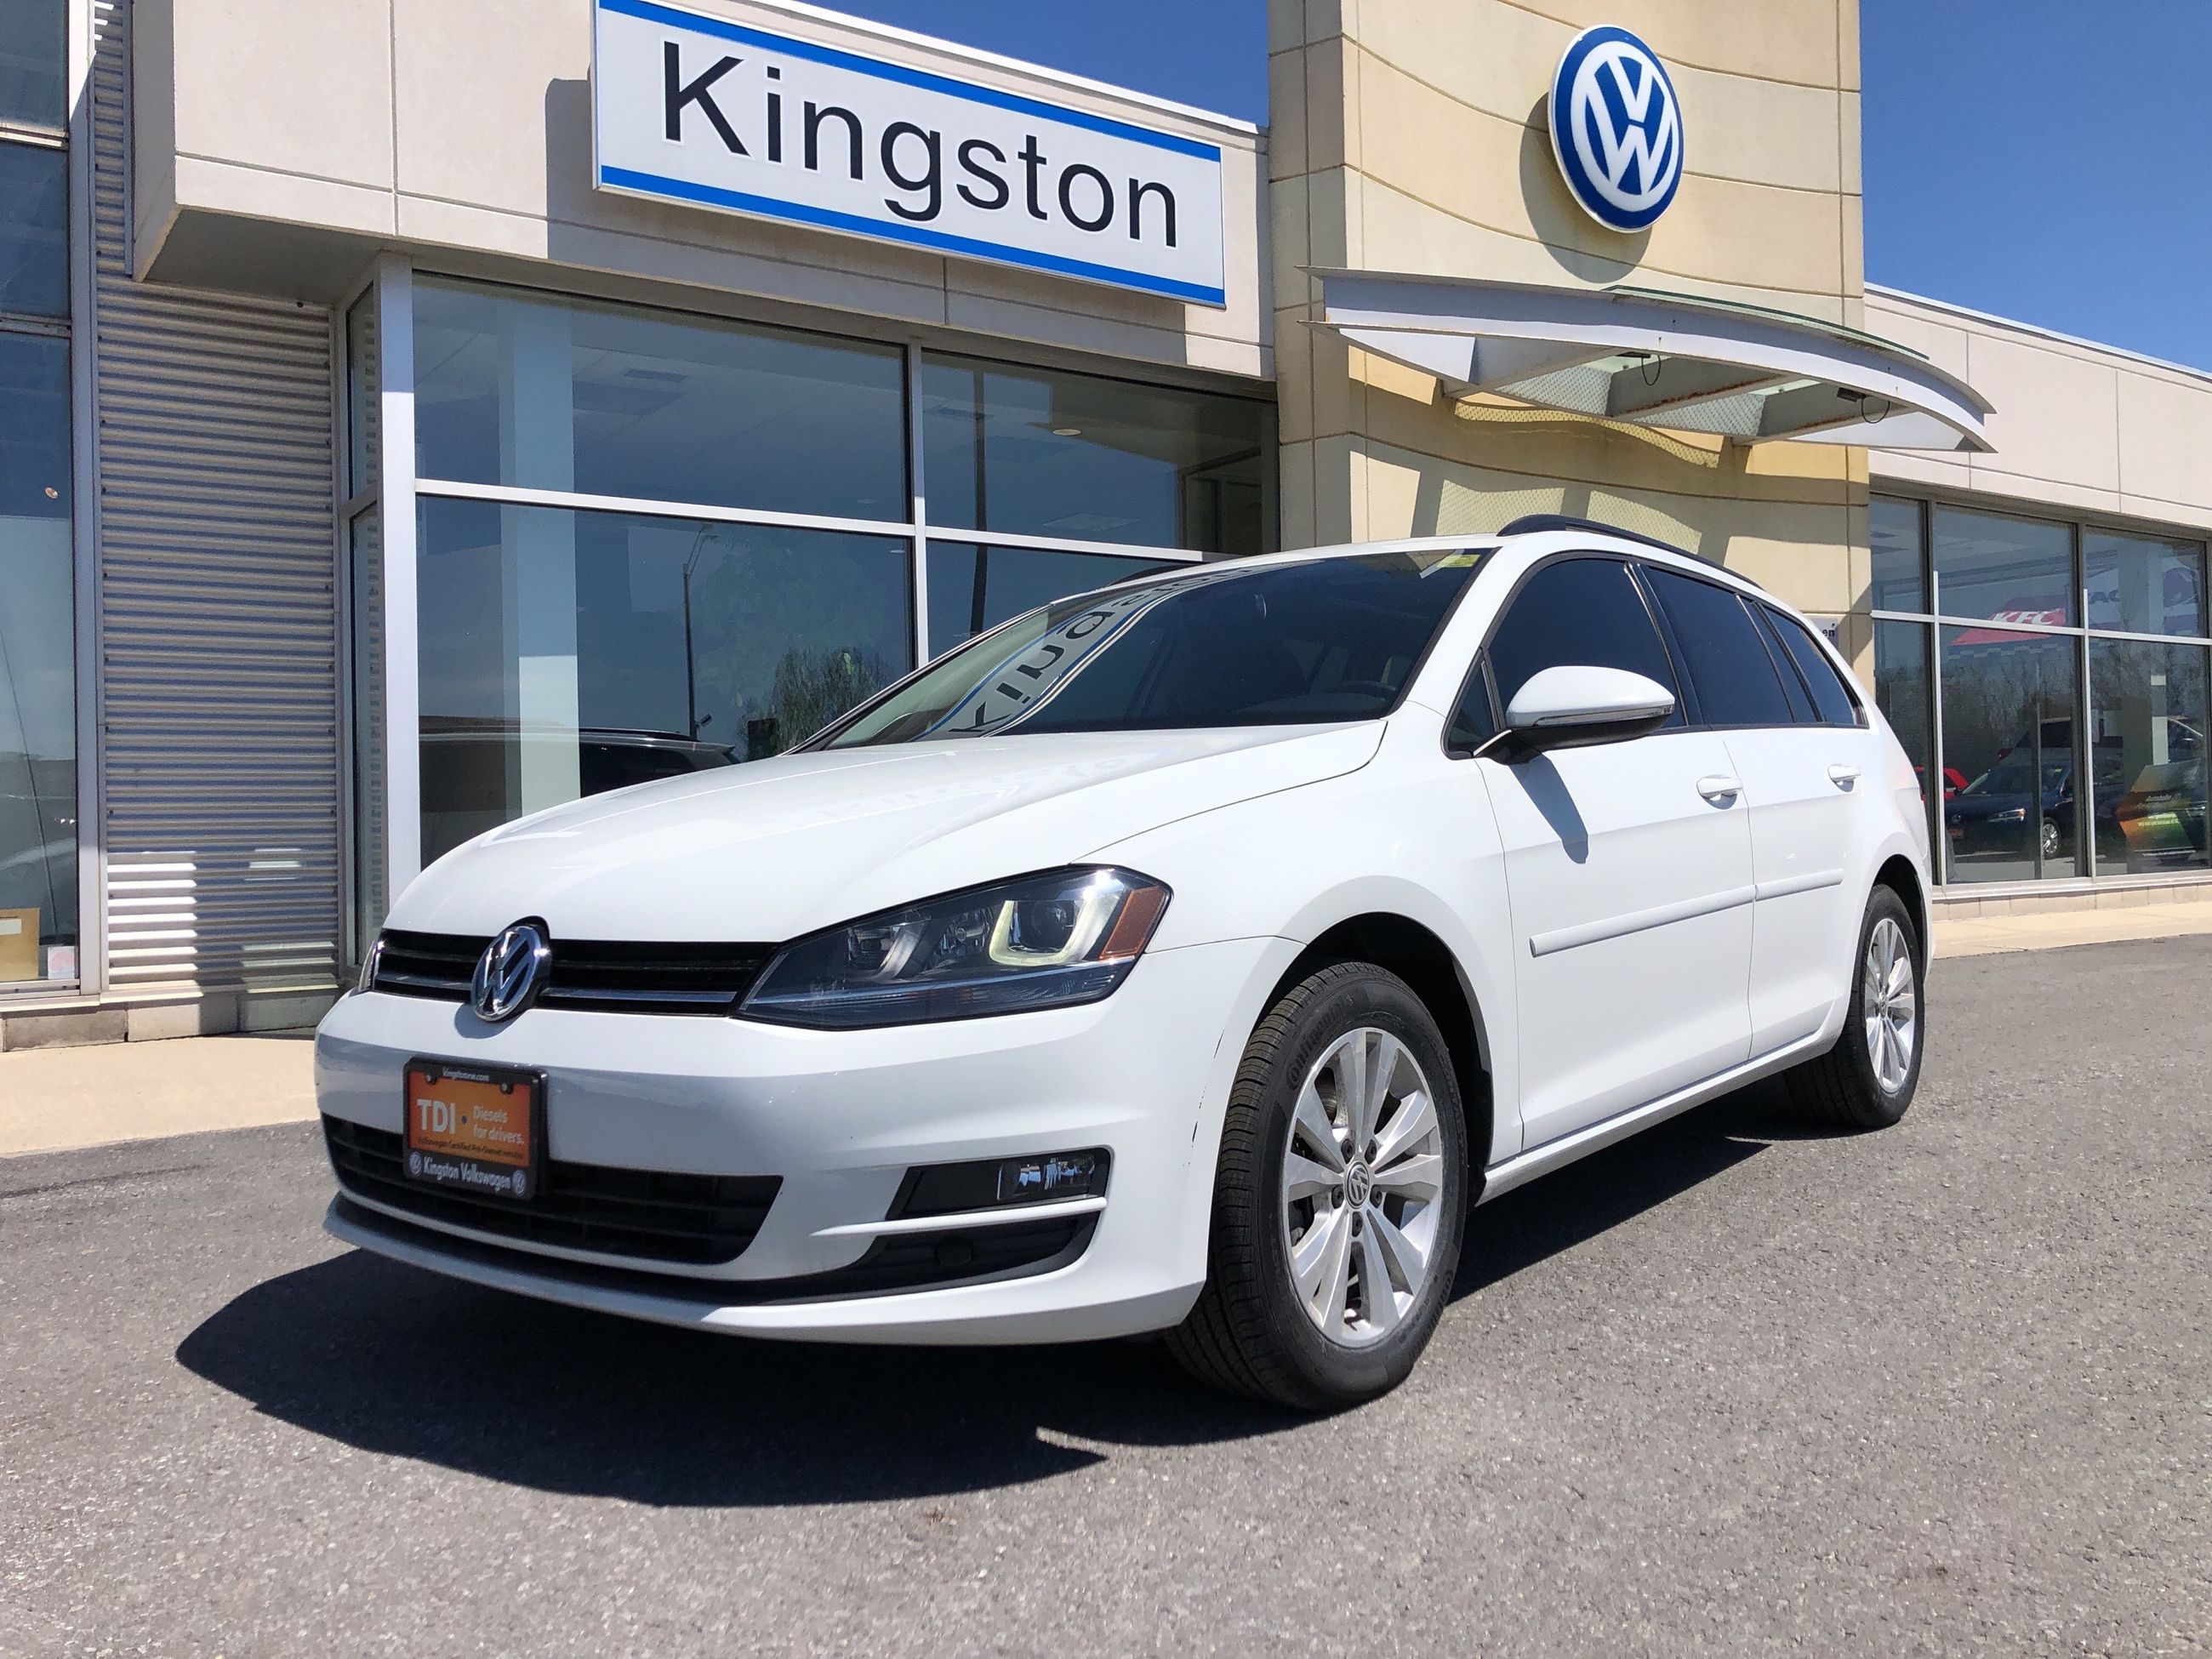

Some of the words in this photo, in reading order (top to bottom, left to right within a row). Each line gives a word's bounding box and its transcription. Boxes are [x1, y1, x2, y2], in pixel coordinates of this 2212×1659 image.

[663, 40, 1177, 248] Kingston
[1993, 610, 2055, 625] KFC
[417, 1098, 457, 1135] TDI
[473, 1105, 508, 1123] Diesels
[473, 1124, 487, 1138] for
[424, 1155, 459, 1182] Kingston
[460, 1162, 511, 1193] Volkswagen
